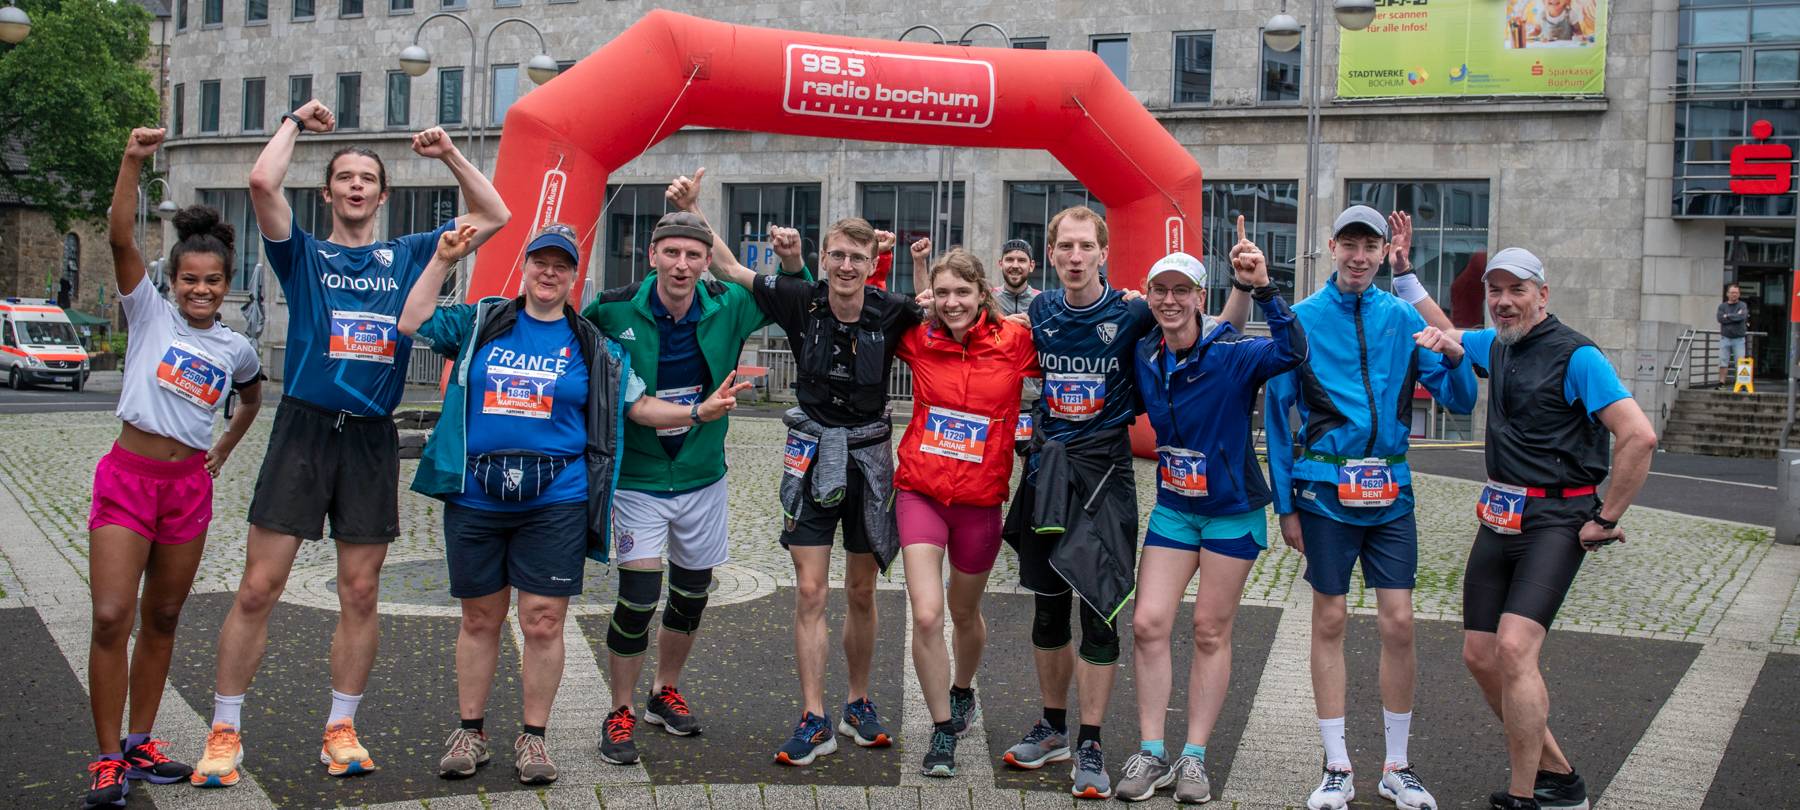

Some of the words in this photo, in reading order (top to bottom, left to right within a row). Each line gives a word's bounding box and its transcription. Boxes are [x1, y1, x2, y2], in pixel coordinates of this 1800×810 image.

[1389, 11, 1428, 19] scannen
[1382, 24, 1399, 32] alle
[1401, 22, 1428, 32] Infos!
[801, 53, 866, 77] 98.5
[1348, 69, 1404, 78] STADTWERKE
[1548, 67, 1595, 77] Sparkasse
[1548, 79, 1585, 87] Bochum
[802, 80, 871, 100] radio
[875, 83, 979, 107] bochum
[355, 333, 377, 343] 2809
[345, 343, 383, 353] LEANDER
[487, 346, 569, 376] FRANCE
[183, 369, 206, 386] 2590
[174, 377, 203, 395] LEONIE
[508, 388, 530, 399] 1848
[497, 399, 538, 409] MARTINIQUE
[1060, 404, 1087, 413] PHILIPP
[944, 430, 965, 442] 1729
[938, 440, 967, 451] ARIANE
[1362, 480, 1383, 489] 4620
[1362, 490, 1383, 498] BENT
